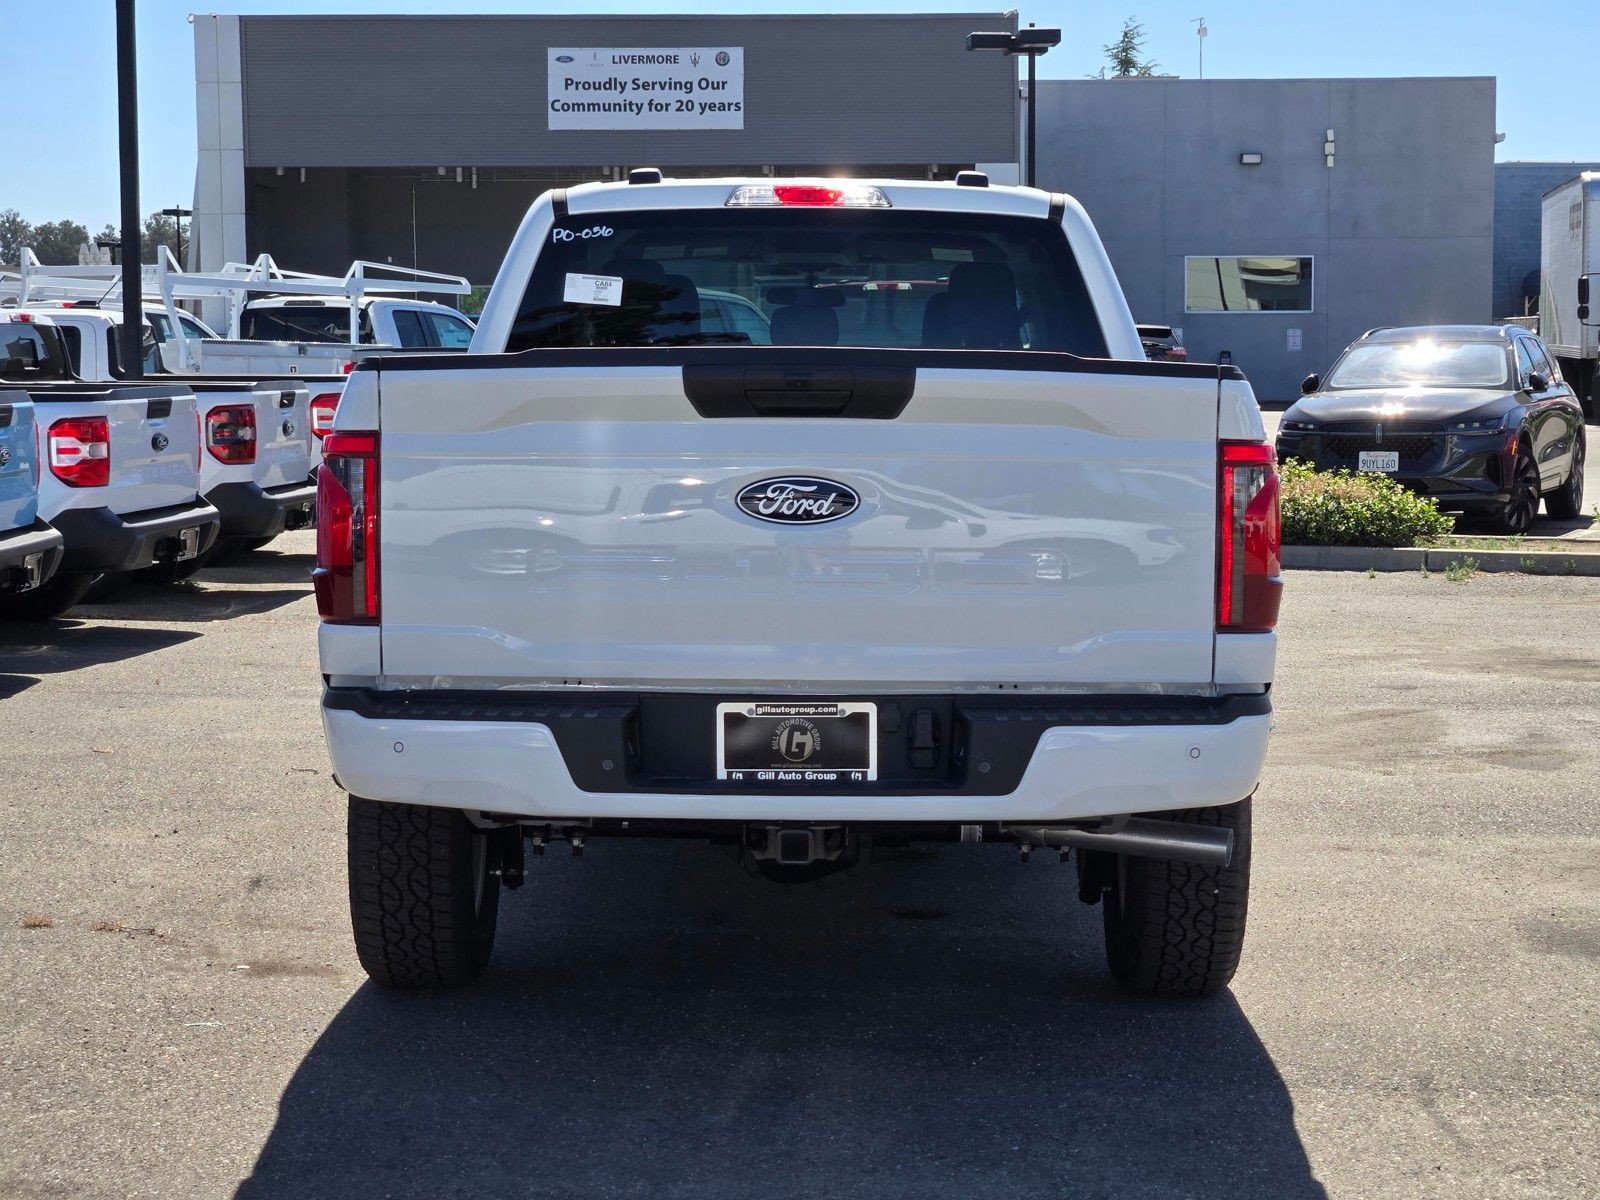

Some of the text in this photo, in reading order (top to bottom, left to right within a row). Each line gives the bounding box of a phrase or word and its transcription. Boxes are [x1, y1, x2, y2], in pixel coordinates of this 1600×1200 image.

[612, 55, 679, 64] LIVERMORE
[564, 77, 727, 94] Proudly Serving Our
[551, 99, 741, 115] Community for 20 years
[1361, 459, 1395, 468] 9UYL160
[758, 483, 837, 515] Ford
[756, 705, 837, 714] gillautogroup.com
[771, 718, 821, 750] GILL AUTOMOTIVE GROUP
[757, 772, 837, 781] Gill Auto Group
